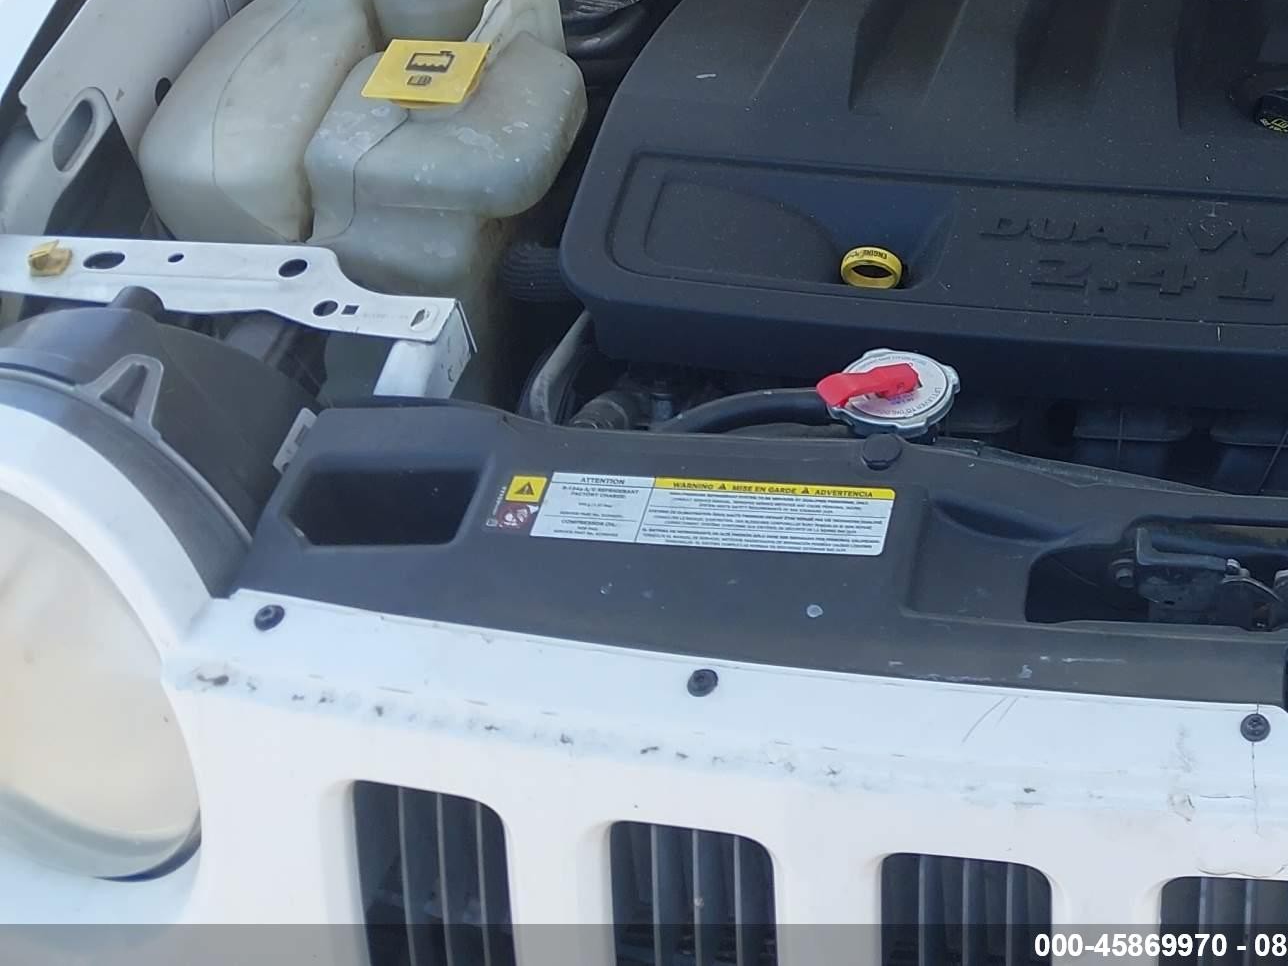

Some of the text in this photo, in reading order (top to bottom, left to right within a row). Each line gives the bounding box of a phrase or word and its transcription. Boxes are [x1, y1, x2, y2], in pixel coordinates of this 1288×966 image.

[979, 215, 1171, 250] DUAL
[1030, 257, 1276, 303] 2.4L
[581, 477, 625, 485] ATTENTION
[673, 481, 873, 498] WARNING MISE EN GARDE ADVERTENCIA
